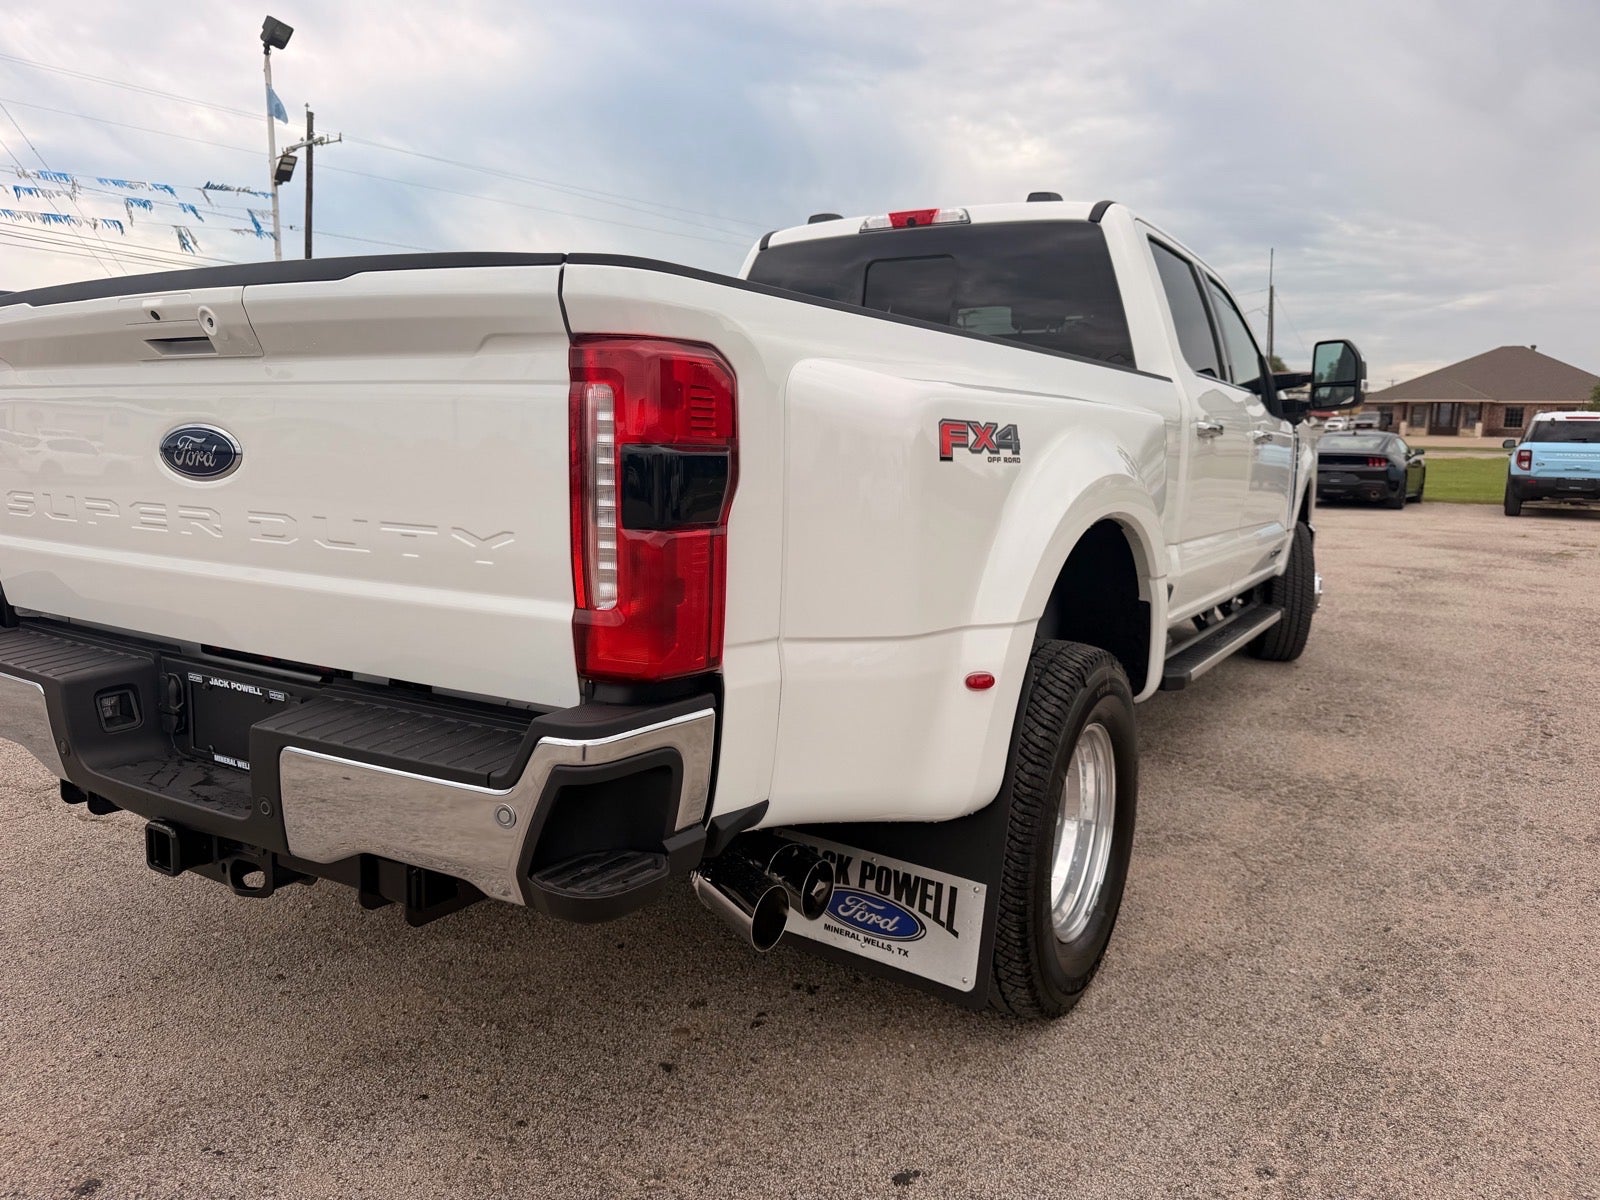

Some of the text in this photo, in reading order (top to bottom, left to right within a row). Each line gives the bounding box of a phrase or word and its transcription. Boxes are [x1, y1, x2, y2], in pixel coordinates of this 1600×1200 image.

[173, 435, 218, 467] Ford
[938, 418, 1021, 462] FX4
[1003, 456, 1021, 464] ROAD
[6, 489, 515, 565] SUPER DUTY
[209, 678, 262, 695] JACK POWELL
[214, 755, 236, 766] MINERAL
[837, 895, 900, 932] Ford
[858, 860, 960, 939] POWELL
[823, 923, 910, 958] MINERAL WELLS, TX
